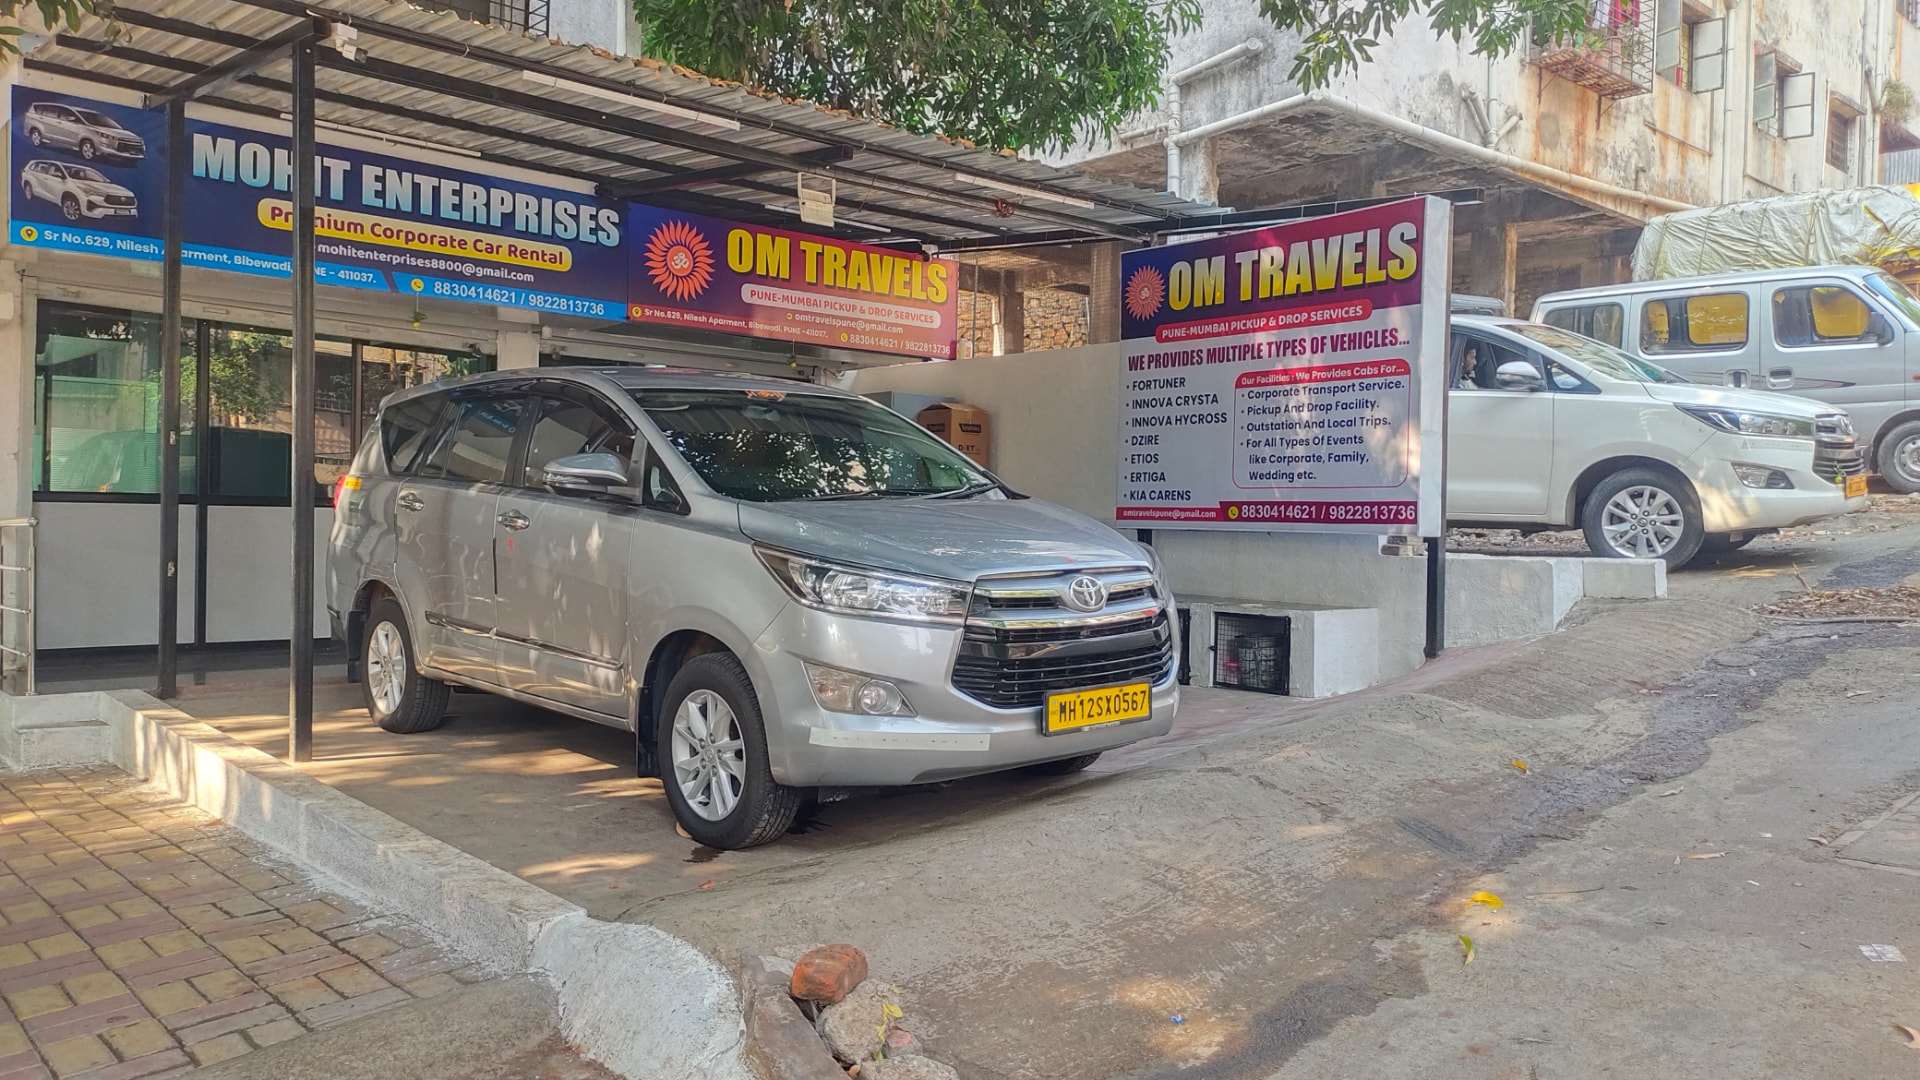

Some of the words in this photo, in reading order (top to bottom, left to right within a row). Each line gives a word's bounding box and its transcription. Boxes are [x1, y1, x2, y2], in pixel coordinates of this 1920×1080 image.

[192, 132, 351, 201] MOHIT
[361, 163, 620, 248] ENTERPRISES
[270, 206, 365, 235] Prium
[370, 222, 468, 250] Corporate
[473, 238, 503, 255] Car
[508, 243, 563, 265] Rental
[44, 230, 60, 241] Sr
[62, 232, 113, 250] No.629,
[117, 239, 158, 255] Nilesh
[161, 246, 232, 265] arment,
[233, 255, 293, 273] Bibewadi,
[337, 270, 377, 283] 411037.
[317, 242, 535, 282] mohitenterprises8800@gmail.com
[727, 228, 791, 280] OM
[800, 240, 948, 303] TRAVELS
[1168, 255, 1225, 311] OM
[1235, 222, 1418, 302] TRAVELS
[434, 281, 516, 304] 8830414621
[520, 292, 525, 304] /
[528, 293, 605, 315] 9822813736
[750, 289, 822, 308] PUNE-MUMBAI
[824, 300, 857, 312] PICKUP
[859, 306, 866, 314] &
[868, 307, 893, 317] DROP
[894, 310, 935, 324] SERVICES
[684, 313, 707, 323] Nilesh
[708, 316, 747, 328] Aparment,
[784, 326, 801, 334] PUNE
[795, 313, 904, 334] omtravelspune@gmail.com
[1162, 323, 1229, 339] PUNE-MUMBAI
[1230, 317, 1267, 332] PICKUP
[1268, 317, 1276, 326] &
[1278, 312, 1308, 326] DROP
[1310, 305, 1363, 321] SERVICES
[850, 333, 898, 348] 8830414621
[905, 341, 950, 355] 9822813736
[1128, 355, 1145, 372] WE
[1148, 348, 1203, 370] PROVIDES
[1206, 343, 1263, 364] MULTIPLE
[1266, 338, 1306, 358] TYPES
[1310, 335, 1327, 354] OF
[1330, 328, 1410, 351] VEHICLES...
[1132, 377, 1186, 391] FORTUNER
[1241, 377, 1255, 385] Our
[1256, 373, 1290, 384] Facilities
[1296, 370, 1311, 381] We
[1312, 366, 1351, 379] Provides
[1353, 364, 1378, 376] Cabs
[1247, 386, 1300, 401] Corporate
[1302, 382, 1356, 398] Transport
[1358, 379, 1405, 392] Service.
[1132, 395, 1173, 409] INNOVA
[1175, 393, 1219, 406] CRYSTA
[1247, 403, 1281, 417] Pickup
[1283, 402, 1305, 414] And
[1307, 401, 1333, 416] Drop
[1335, 398, 1380, 414] Facility.
[1131, 415, 1172, 428] INNOVA
[1175, 412, 1228, 425] HYCROSS
[1247, 420, 1301, 432] Outstation
[1303, 417, 1326, 430] And
[1328, 416, 1357, 428] Local
[1359, 415, 1391, 429] Trips.
[1131, 434, 1160, 446] DZIRE
[1246, 437, 1262, 448] For
[1264, 437, 1277, 447] All
[1278, 436, 1311, 450] Types
[1312, 435, 1326, 446] Of
[1327, 434, 1364, 446] Events
[1130, 453, 1159, 464] ETIOS
[1249, 453, 1267, 464] like
[1269, 452, 1325, 467] Corporate,
[1328, 451, 1369, 465] Family,
[1130, 472, 1166, 483] ERTIGA
[1249, 469, 1295, 483] Wedding
[1297, 470, 1317, 481] etc.
[1129, 490, 1147, 501] KIA
[1149, 489, 1191, 501] CARENS
[1123, 510, 1216, 520] omtravelspune@gmail.com
[1241, 504, 1317, 519] 8830414621
[1321, 505, 1326, 518] /
[1329, 505, 1416, 520] 9822813736
[1059, 690, 1147, 723] MH12SX0567
